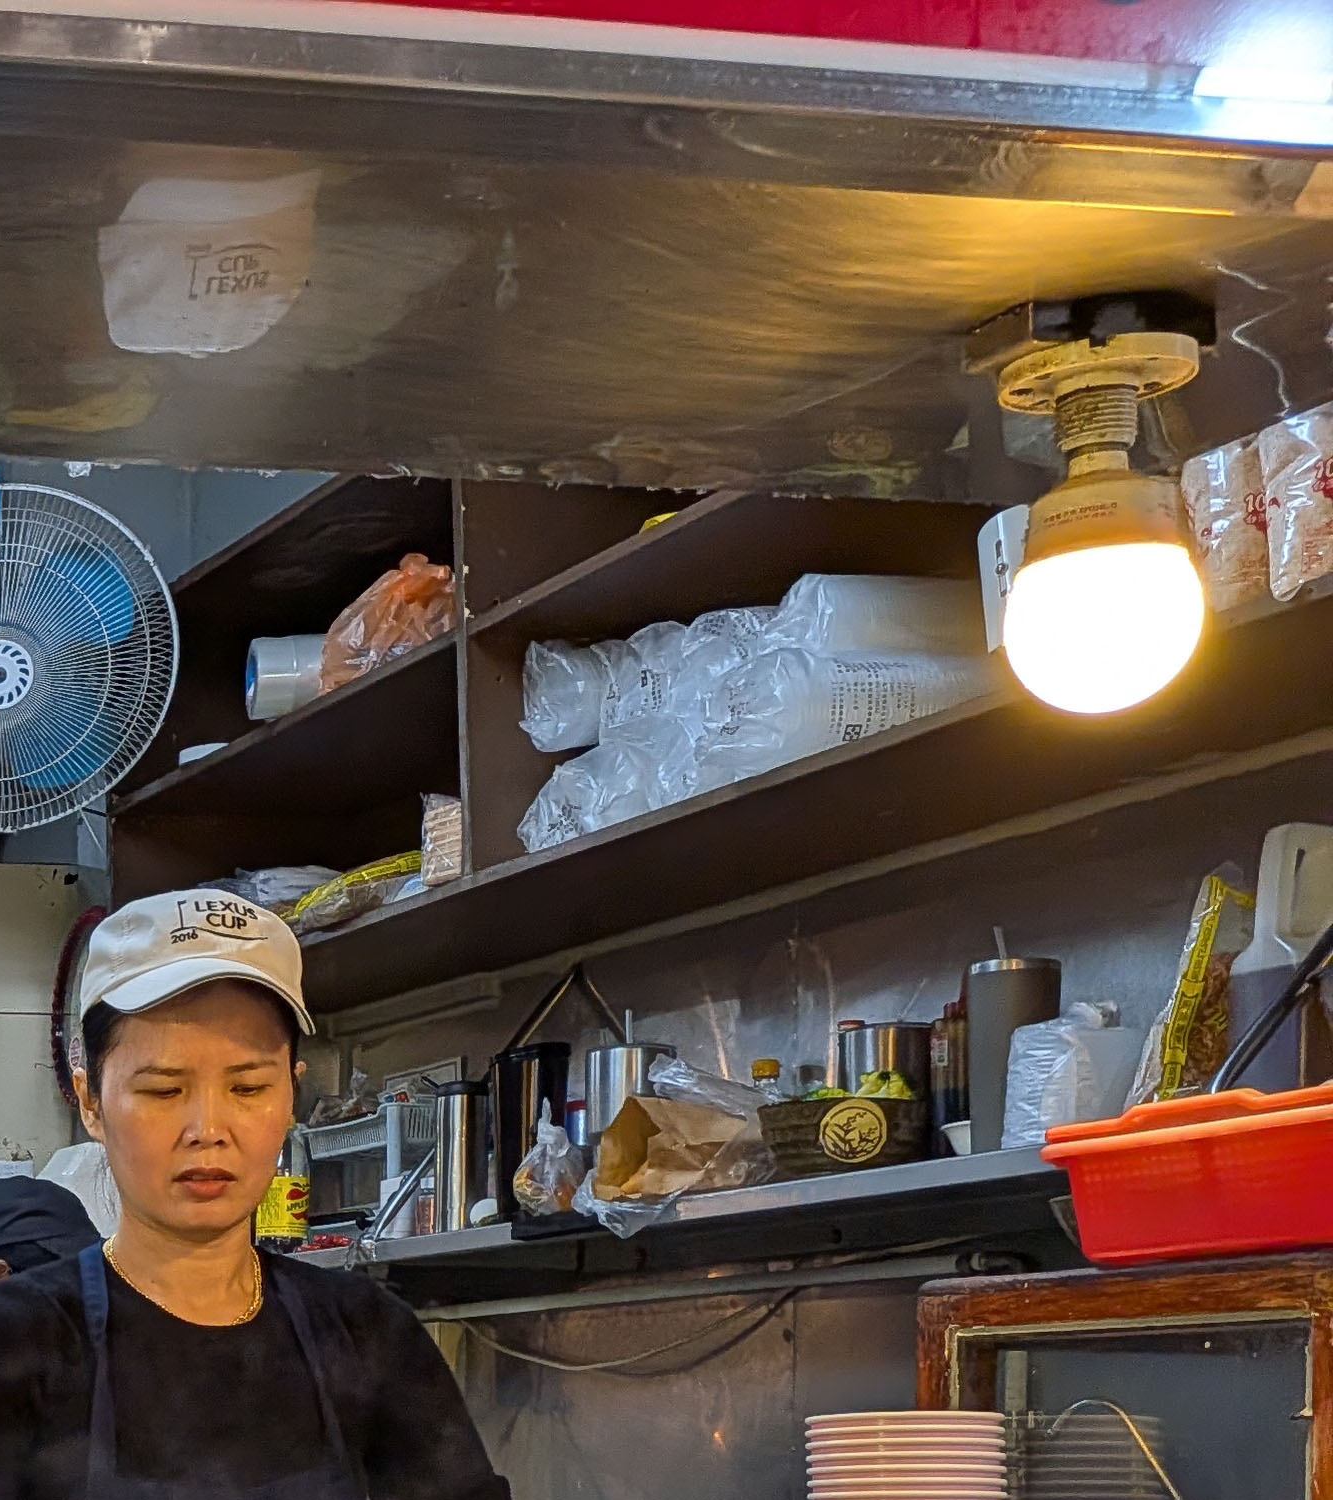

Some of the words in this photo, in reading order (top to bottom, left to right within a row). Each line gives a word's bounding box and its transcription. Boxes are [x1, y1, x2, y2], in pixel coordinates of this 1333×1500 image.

[194, 900, 258, 920] LEXUS
[206, 913, 247, 929] CUP
[171, 929, 198, 944] 2016
